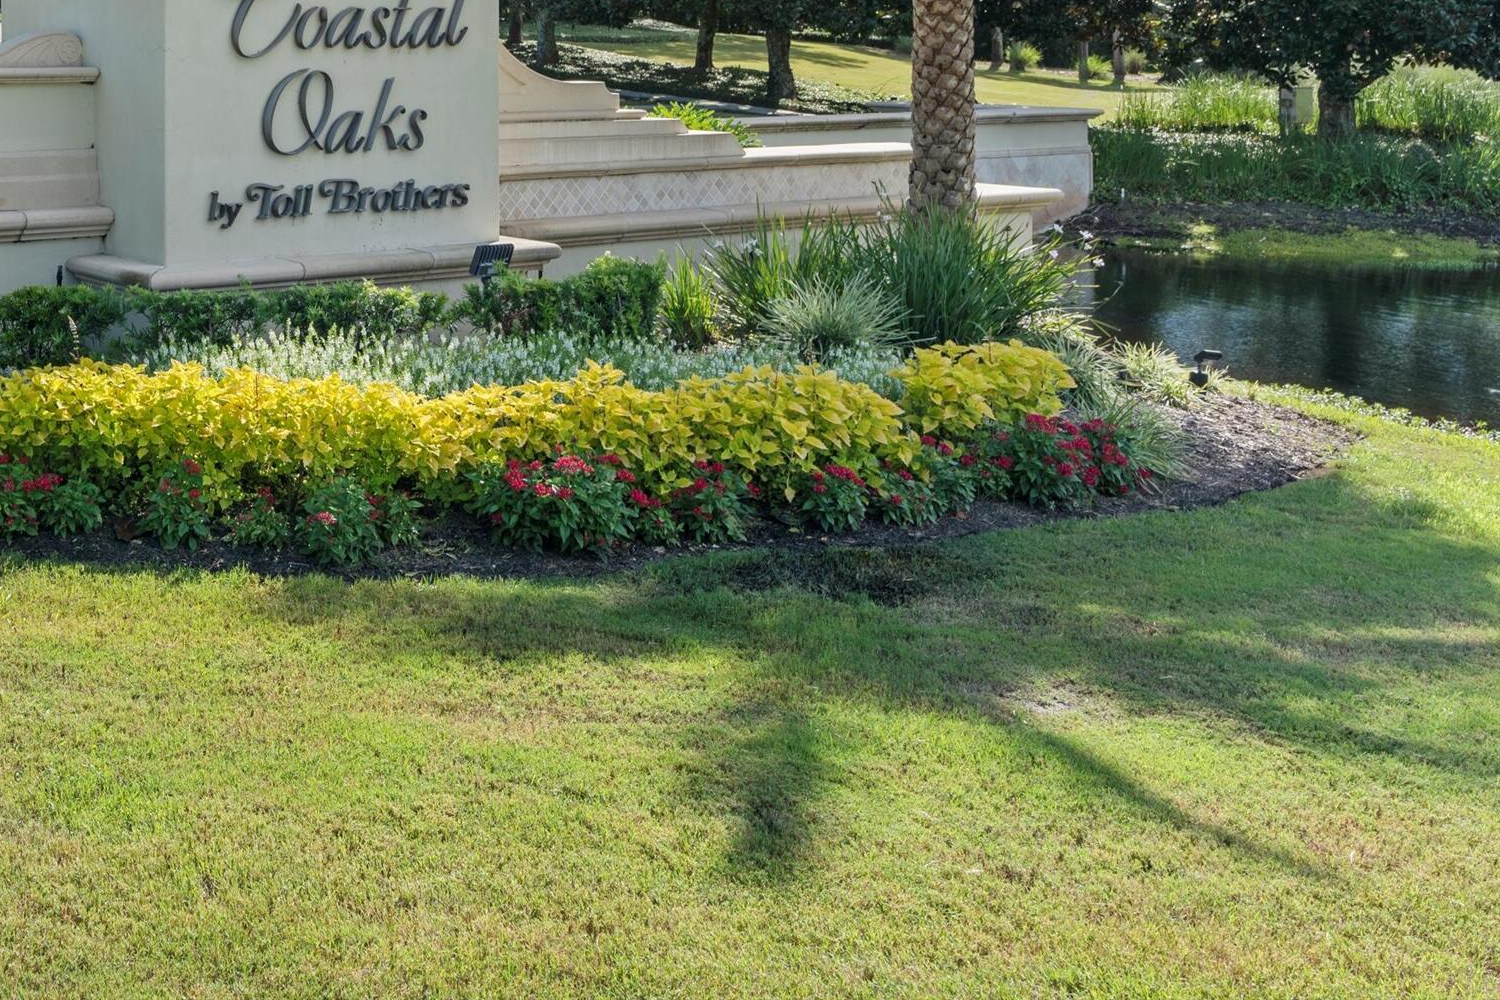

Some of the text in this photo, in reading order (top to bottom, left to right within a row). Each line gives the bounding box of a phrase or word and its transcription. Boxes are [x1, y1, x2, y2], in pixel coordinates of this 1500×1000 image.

[262, 68, 428, 156] Oaks
[208, 178, 470, 229] by Toll Brothers
